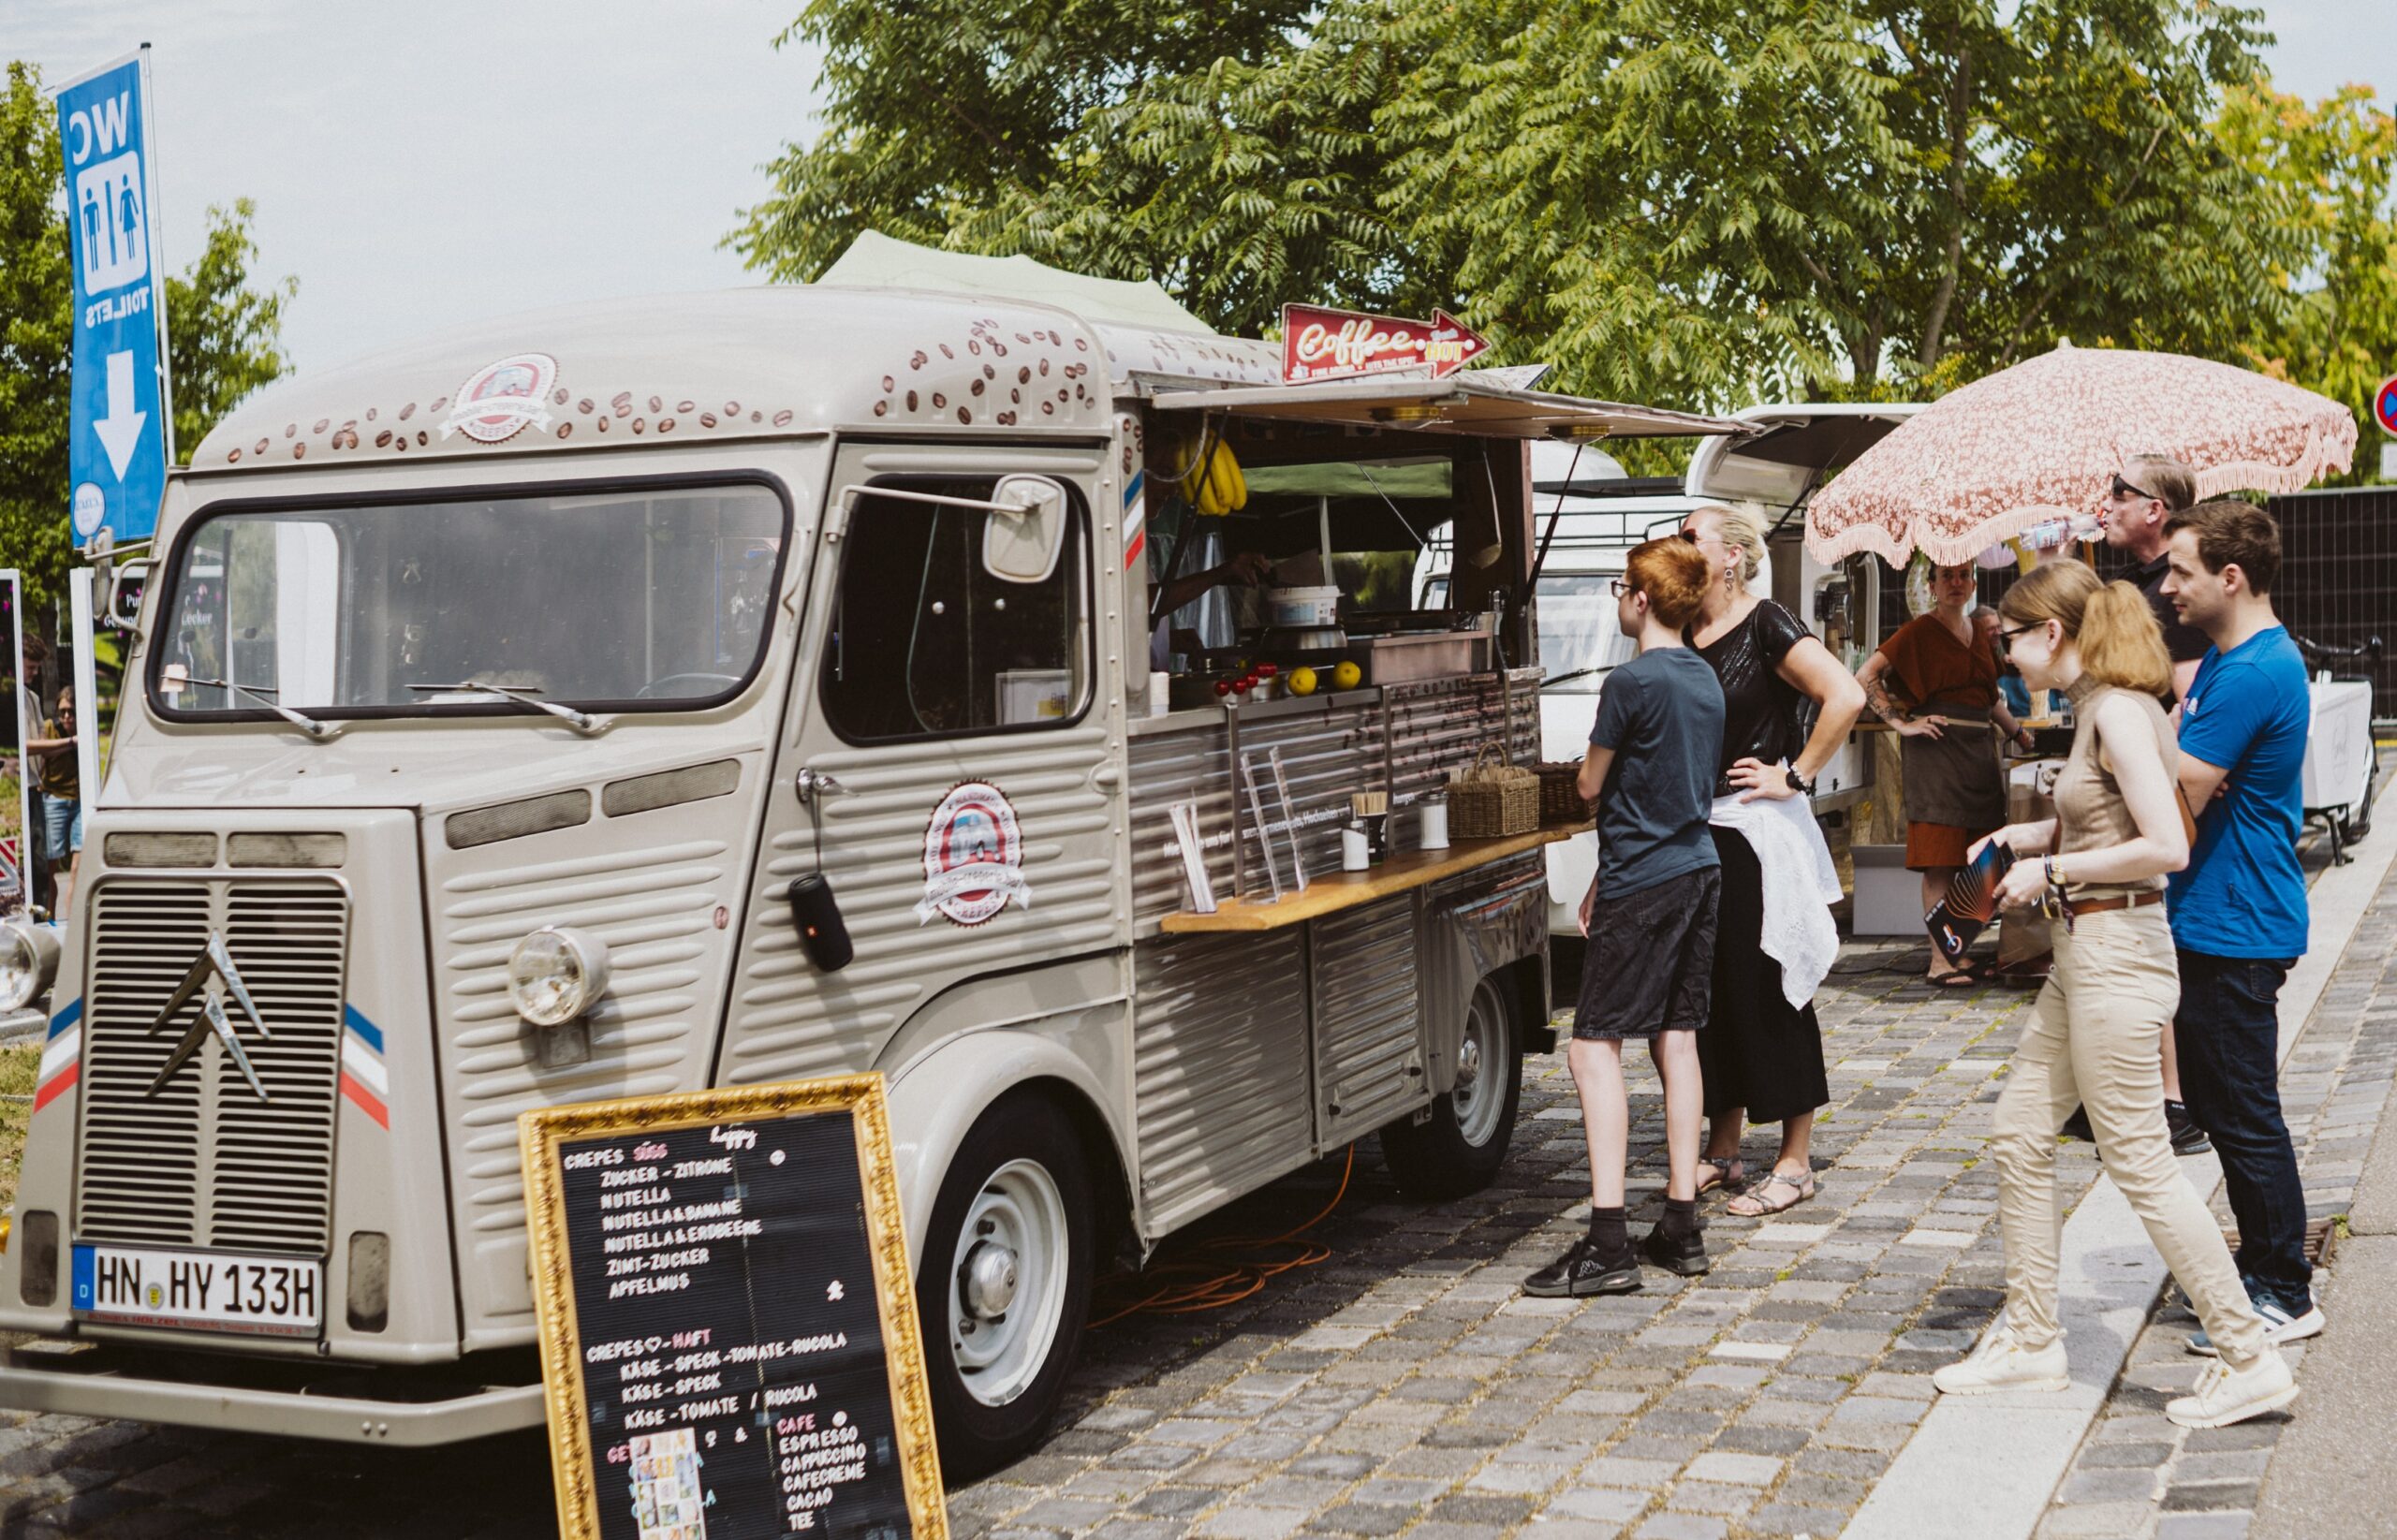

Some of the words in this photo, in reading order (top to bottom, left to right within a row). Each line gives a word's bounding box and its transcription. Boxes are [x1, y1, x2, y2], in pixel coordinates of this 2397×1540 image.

[1296, 319, 1417, 366] Coffee
[1425, 341, 1463, 362] HOT
[564, 1148, 625, 1170] CREPES
[600, 1187, 671, 1210] NUTELLA
[79, 1283, 88, 1298] D
[97, 1255, 140, 1306] HN
[170, 1260, 213, 1310] HY
[225, 1264, 314, 1317] 133H
[609, 1272, 691, 1299] APFELMUS
[765, 1384, 817, 1406] RUCOLA
[776, 1414, 816, 1435] CAFE
[779, 1425, 859, 1454] ESPRESSO
[781, 1443, 866, 1474] CAPPUCCINO
[787, 1487, 833, 1512] CACAO
[788, 1510, 815, 1531] TEE
